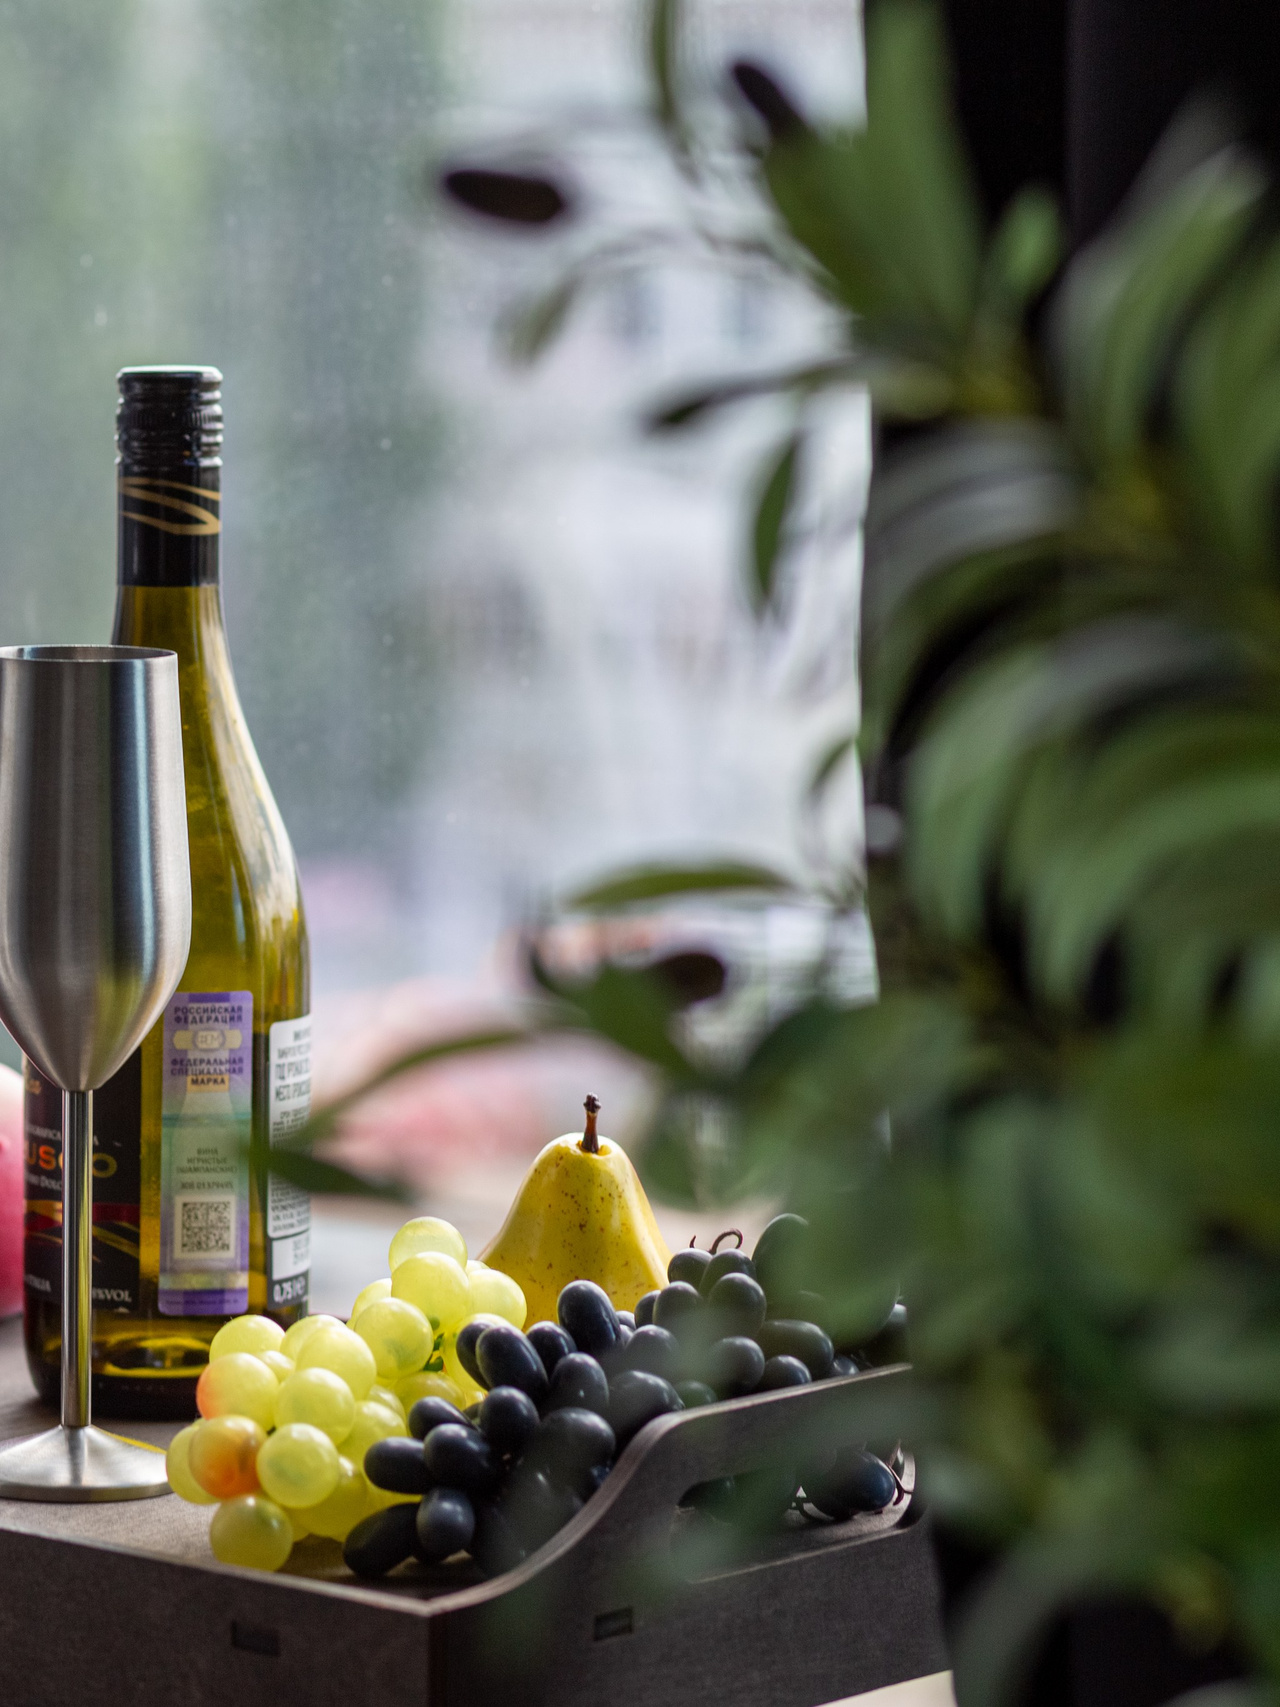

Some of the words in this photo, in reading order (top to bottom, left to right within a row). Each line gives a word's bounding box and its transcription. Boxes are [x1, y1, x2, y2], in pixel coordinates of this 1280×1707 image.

[174, 1004, 243, 1015] РОССИЙСКАЯ
[174, 1015, 243, 1025] ФЕДЕРАЦИЯ
[171, 1057, 244, 1067] ФЕДЕРАЛЬНАЯ
[170, 1066, 244, 1077] СПЕЦИАЛЬНАЯ
[190, 1075, 226, 1086] МАРКА
